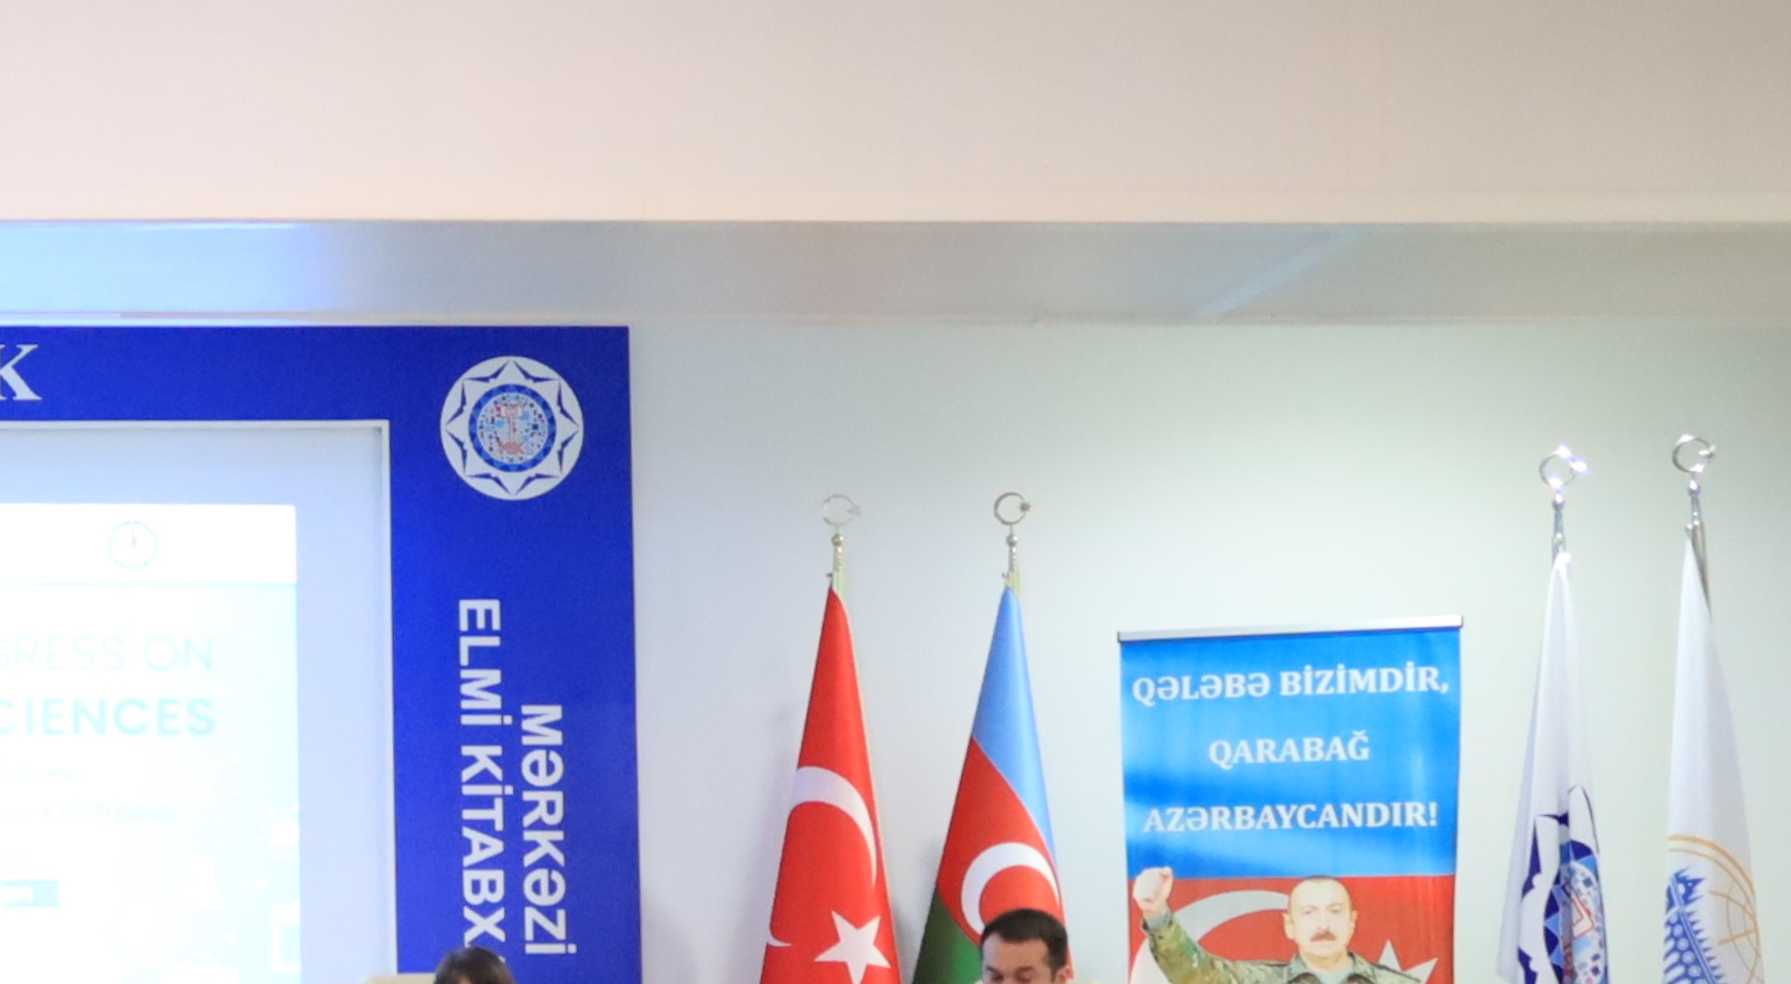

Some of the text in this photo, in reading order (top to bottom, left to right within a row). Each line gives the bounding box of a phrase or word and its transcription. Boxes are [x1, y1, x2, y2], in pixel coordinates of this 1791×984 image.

[142, 633, 215, 673] ON
[1131, 660, 1450, 708] QƏLƏBƏ BİZİMDİR,
[1208, 729, 1370, 771] QARABAĞ
[458, 598, 515, 964] ELMİ KİTABX
[519, 704, 578, 955] MƏRKƏZİ
[1143, 800, 1439, 833] AZƏRBAYCANDIR!
